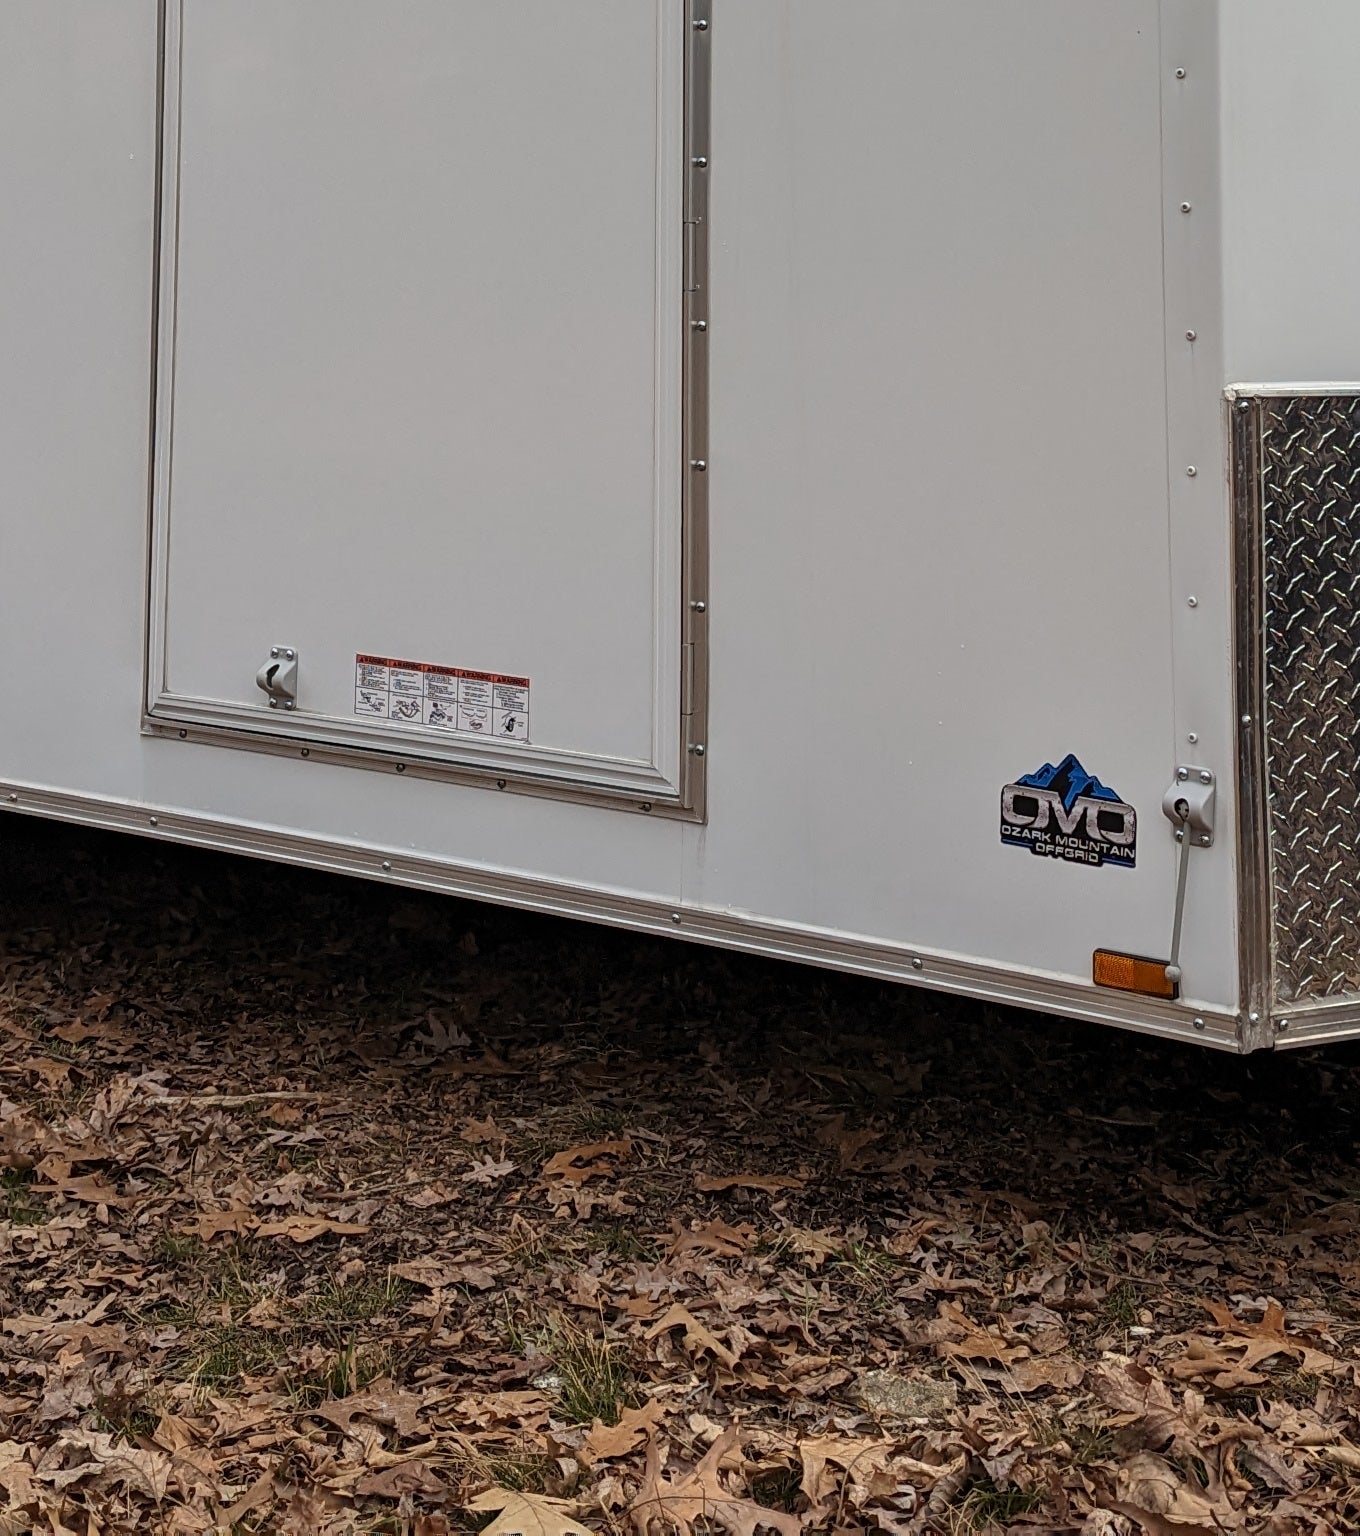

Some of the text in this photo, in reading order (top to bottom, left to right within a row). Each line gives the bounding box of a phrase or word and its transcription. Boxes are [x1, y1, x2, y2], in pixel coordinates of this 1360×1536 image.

[1001, 825, 1136, 858] OZARK MOUNTAIN
[1035, 843, 1099, 863] OFFGRID
